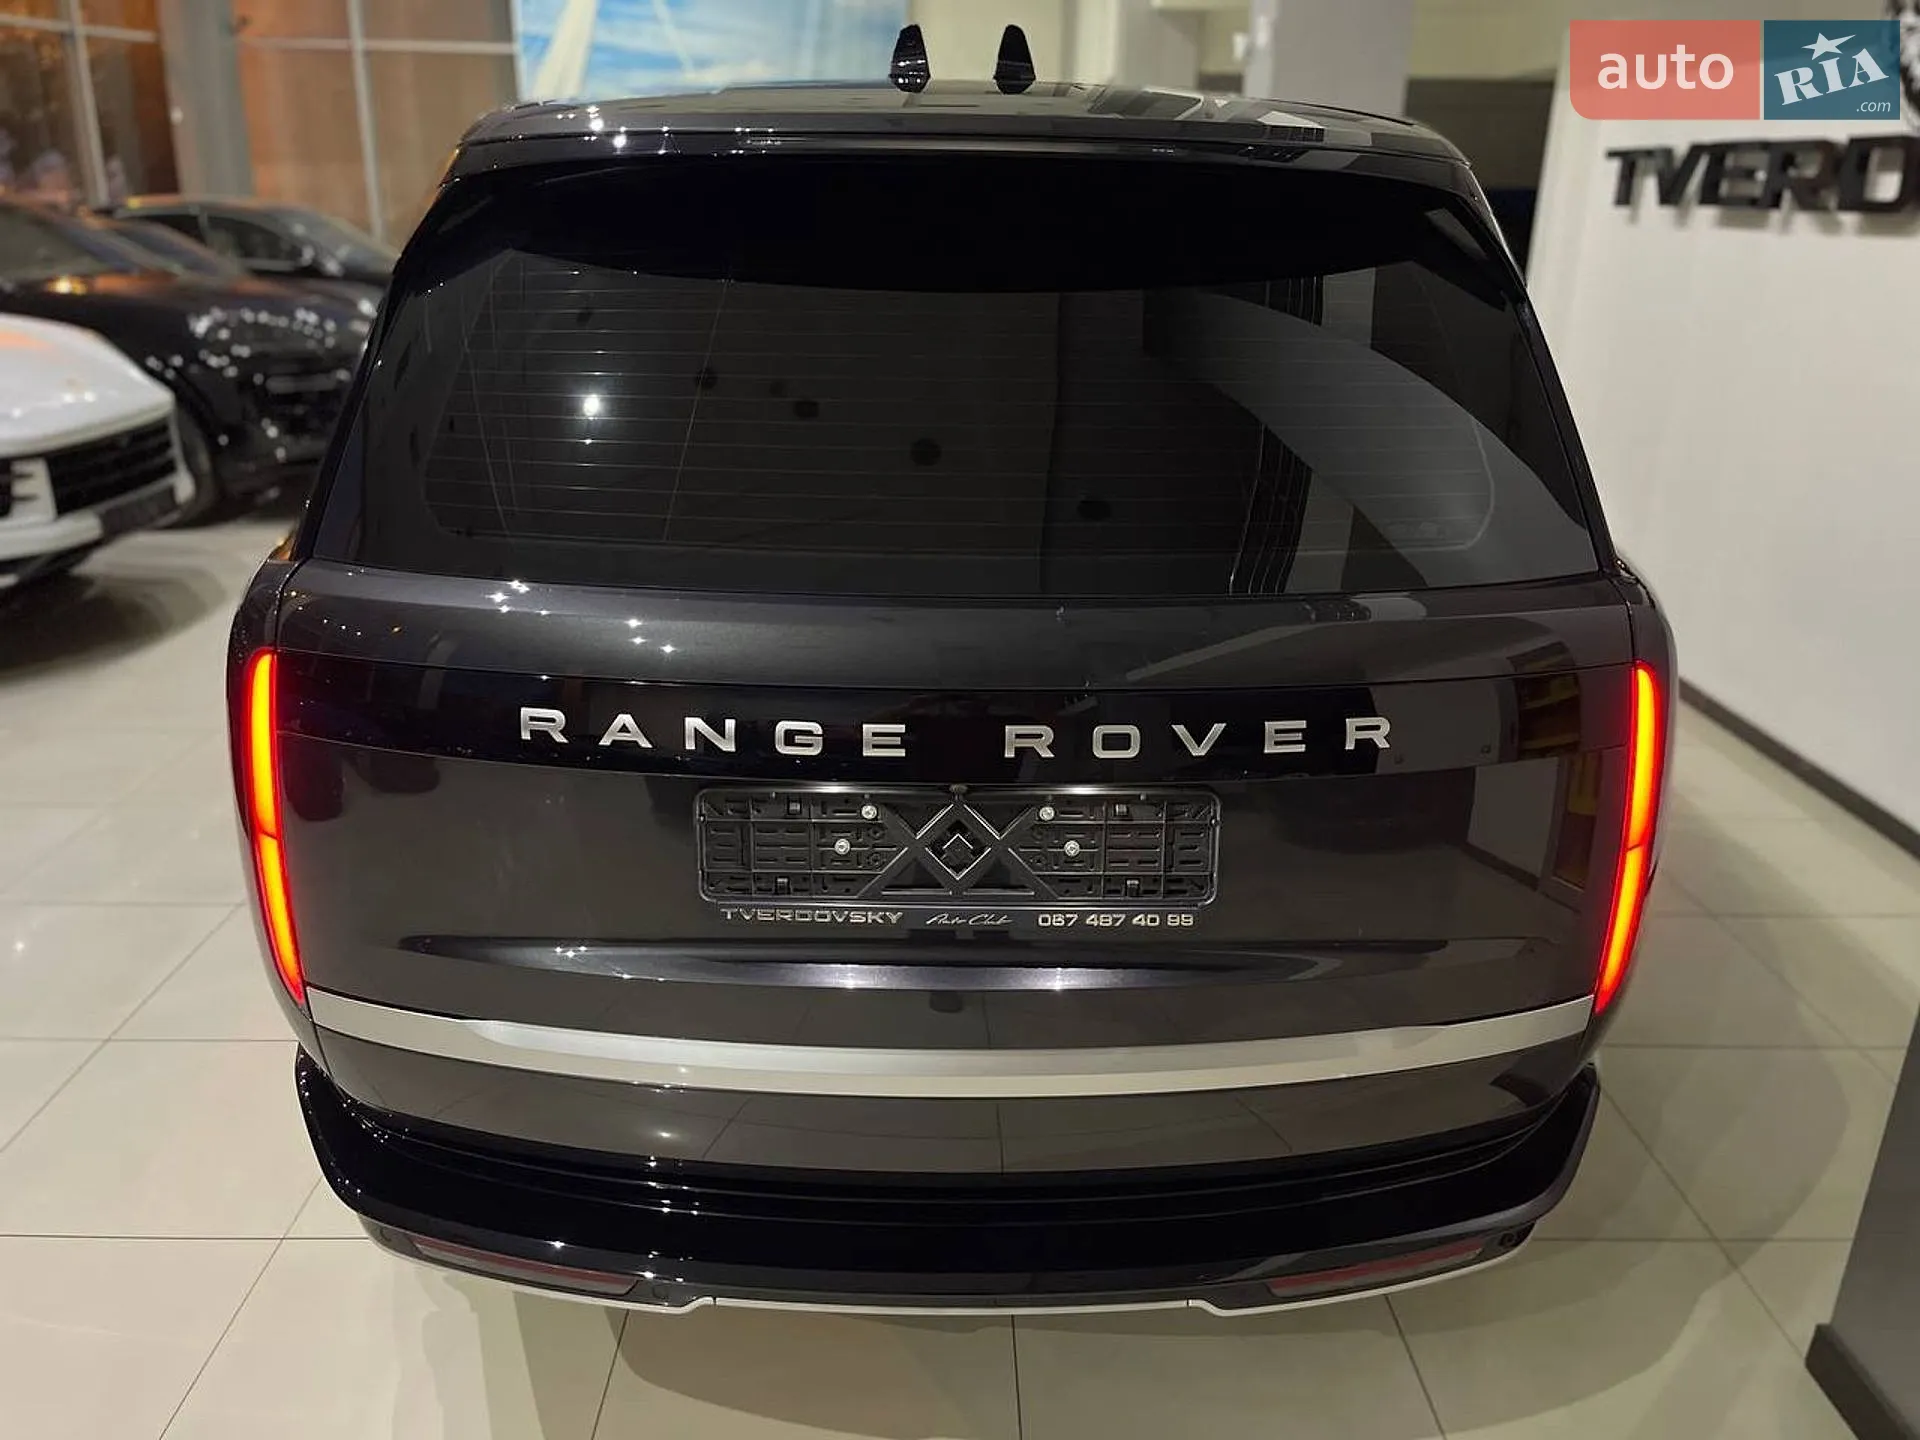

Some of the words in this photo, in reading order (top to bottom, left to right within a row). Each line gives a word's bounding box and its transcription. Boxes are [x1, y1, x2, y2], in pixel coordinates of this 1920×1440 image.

[520, 706, 906, 757] RANGE
[1004, 716, 1391, 759] ROVER
[1038, 913, 1079, 927] 067
[1132, 913, 1161, 927] 40
